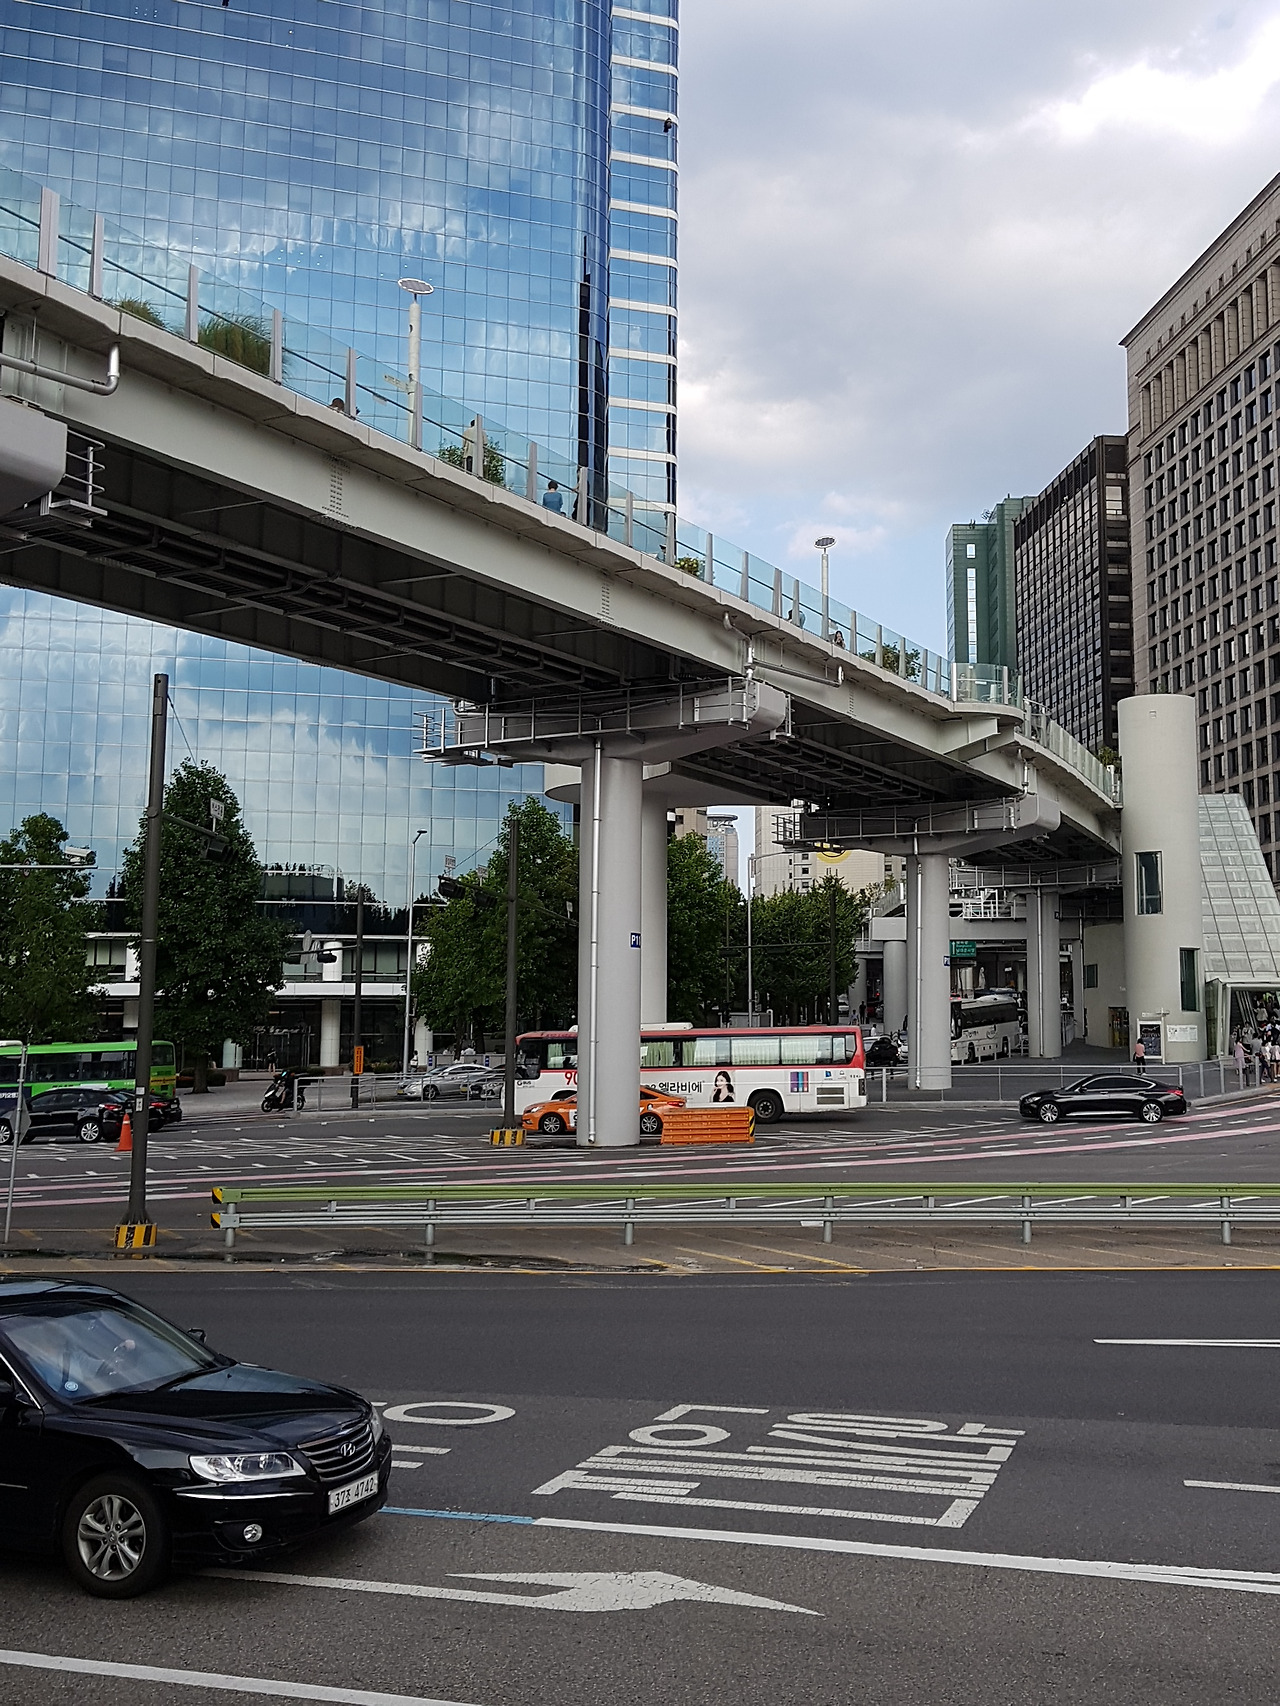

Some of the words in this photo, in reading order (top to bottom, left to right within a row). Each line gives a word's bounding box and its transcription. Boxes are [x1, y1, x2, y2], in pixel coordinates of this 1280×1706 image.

[658, 1081, 702, 1093] 엘라비에
[530, 1404, 1026, 1528] 한강대교
[354, 1478, 374, 1497] 4742
